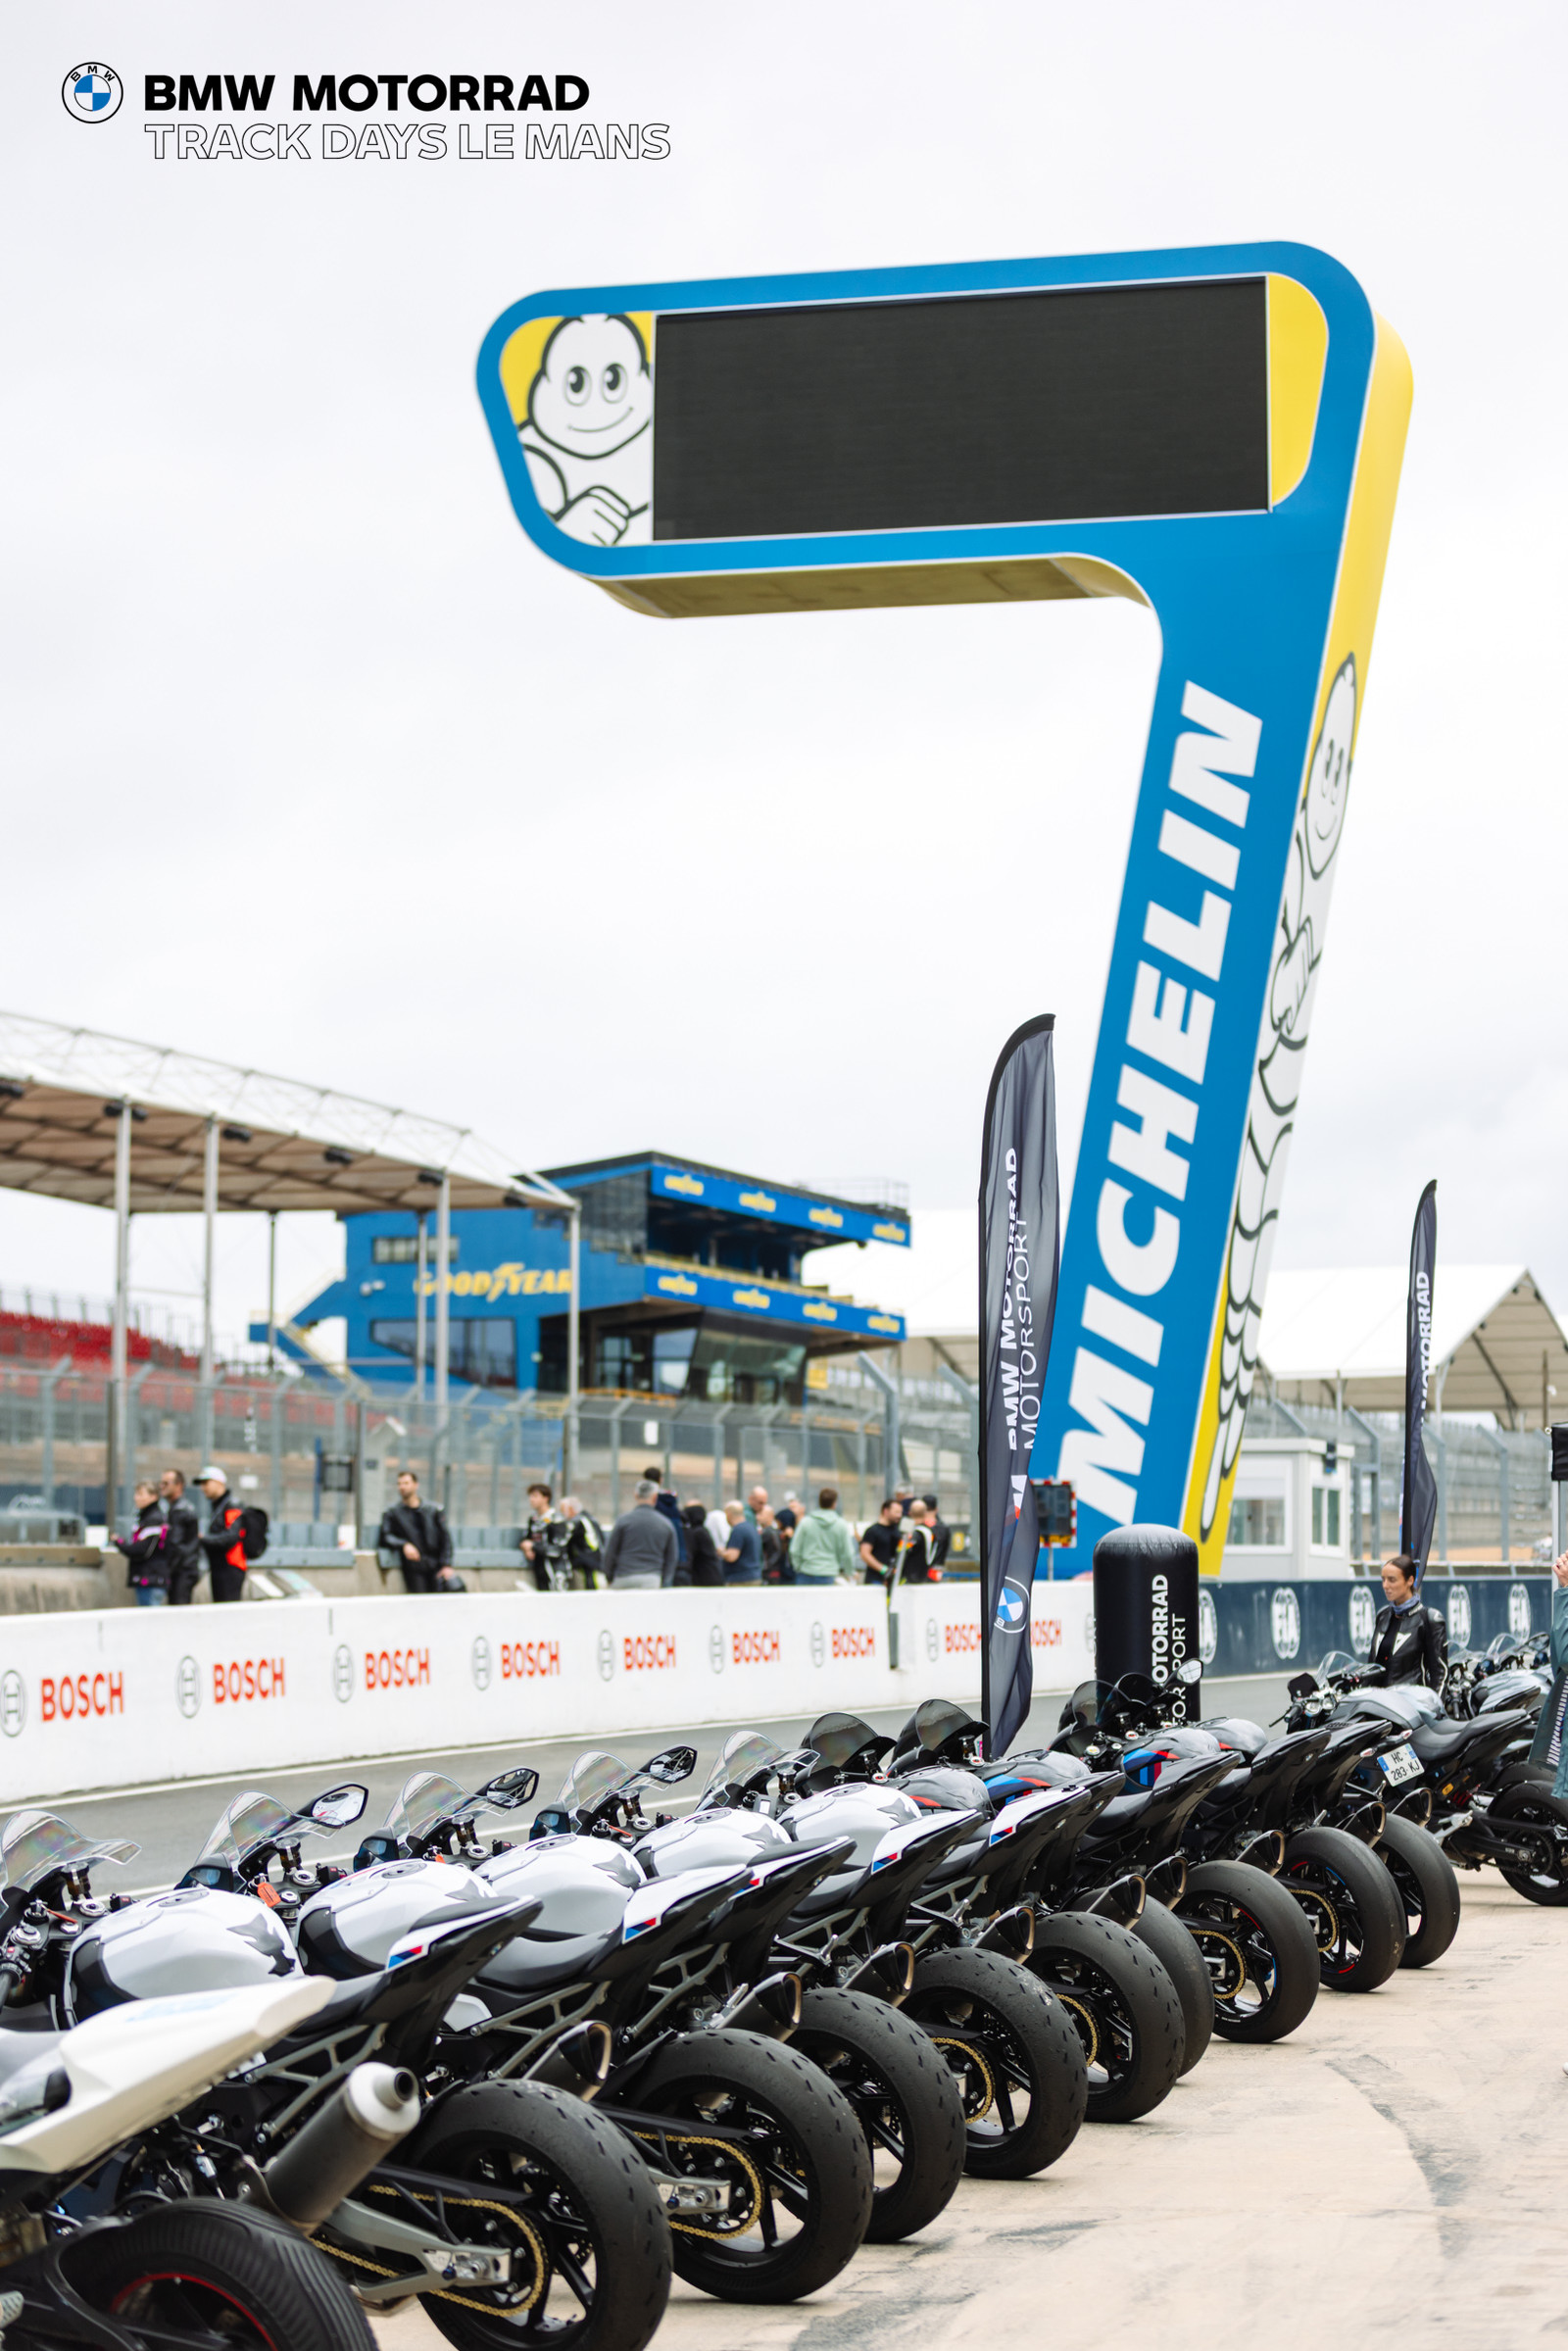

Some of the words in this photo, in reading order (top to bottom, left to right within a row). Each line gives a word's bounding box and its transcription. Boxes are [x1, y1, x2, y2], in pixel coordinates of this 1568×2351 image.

[1057, 679, 1264, 1526] MICHELIN
[1000, 1148, 1018, 1350] MOTORRAD
[1013, 1211, 1042, 1450] MOTORSPORT
[623, 1634, 676, 1671] BOSCH
[732, 1630, 781, 1665] BOSCH
[832, 1627, 875, 1659] BOSCH
[1152, 1574, 1169, 1685] OTORRAD
[212, 1656, 286, 1705] BOSCH
[365, 1646, 431, 1691] BOSCH
[501, 1641, 561, 1680] BOSCH
[40, 1670, 124, 1723] BOSCH
